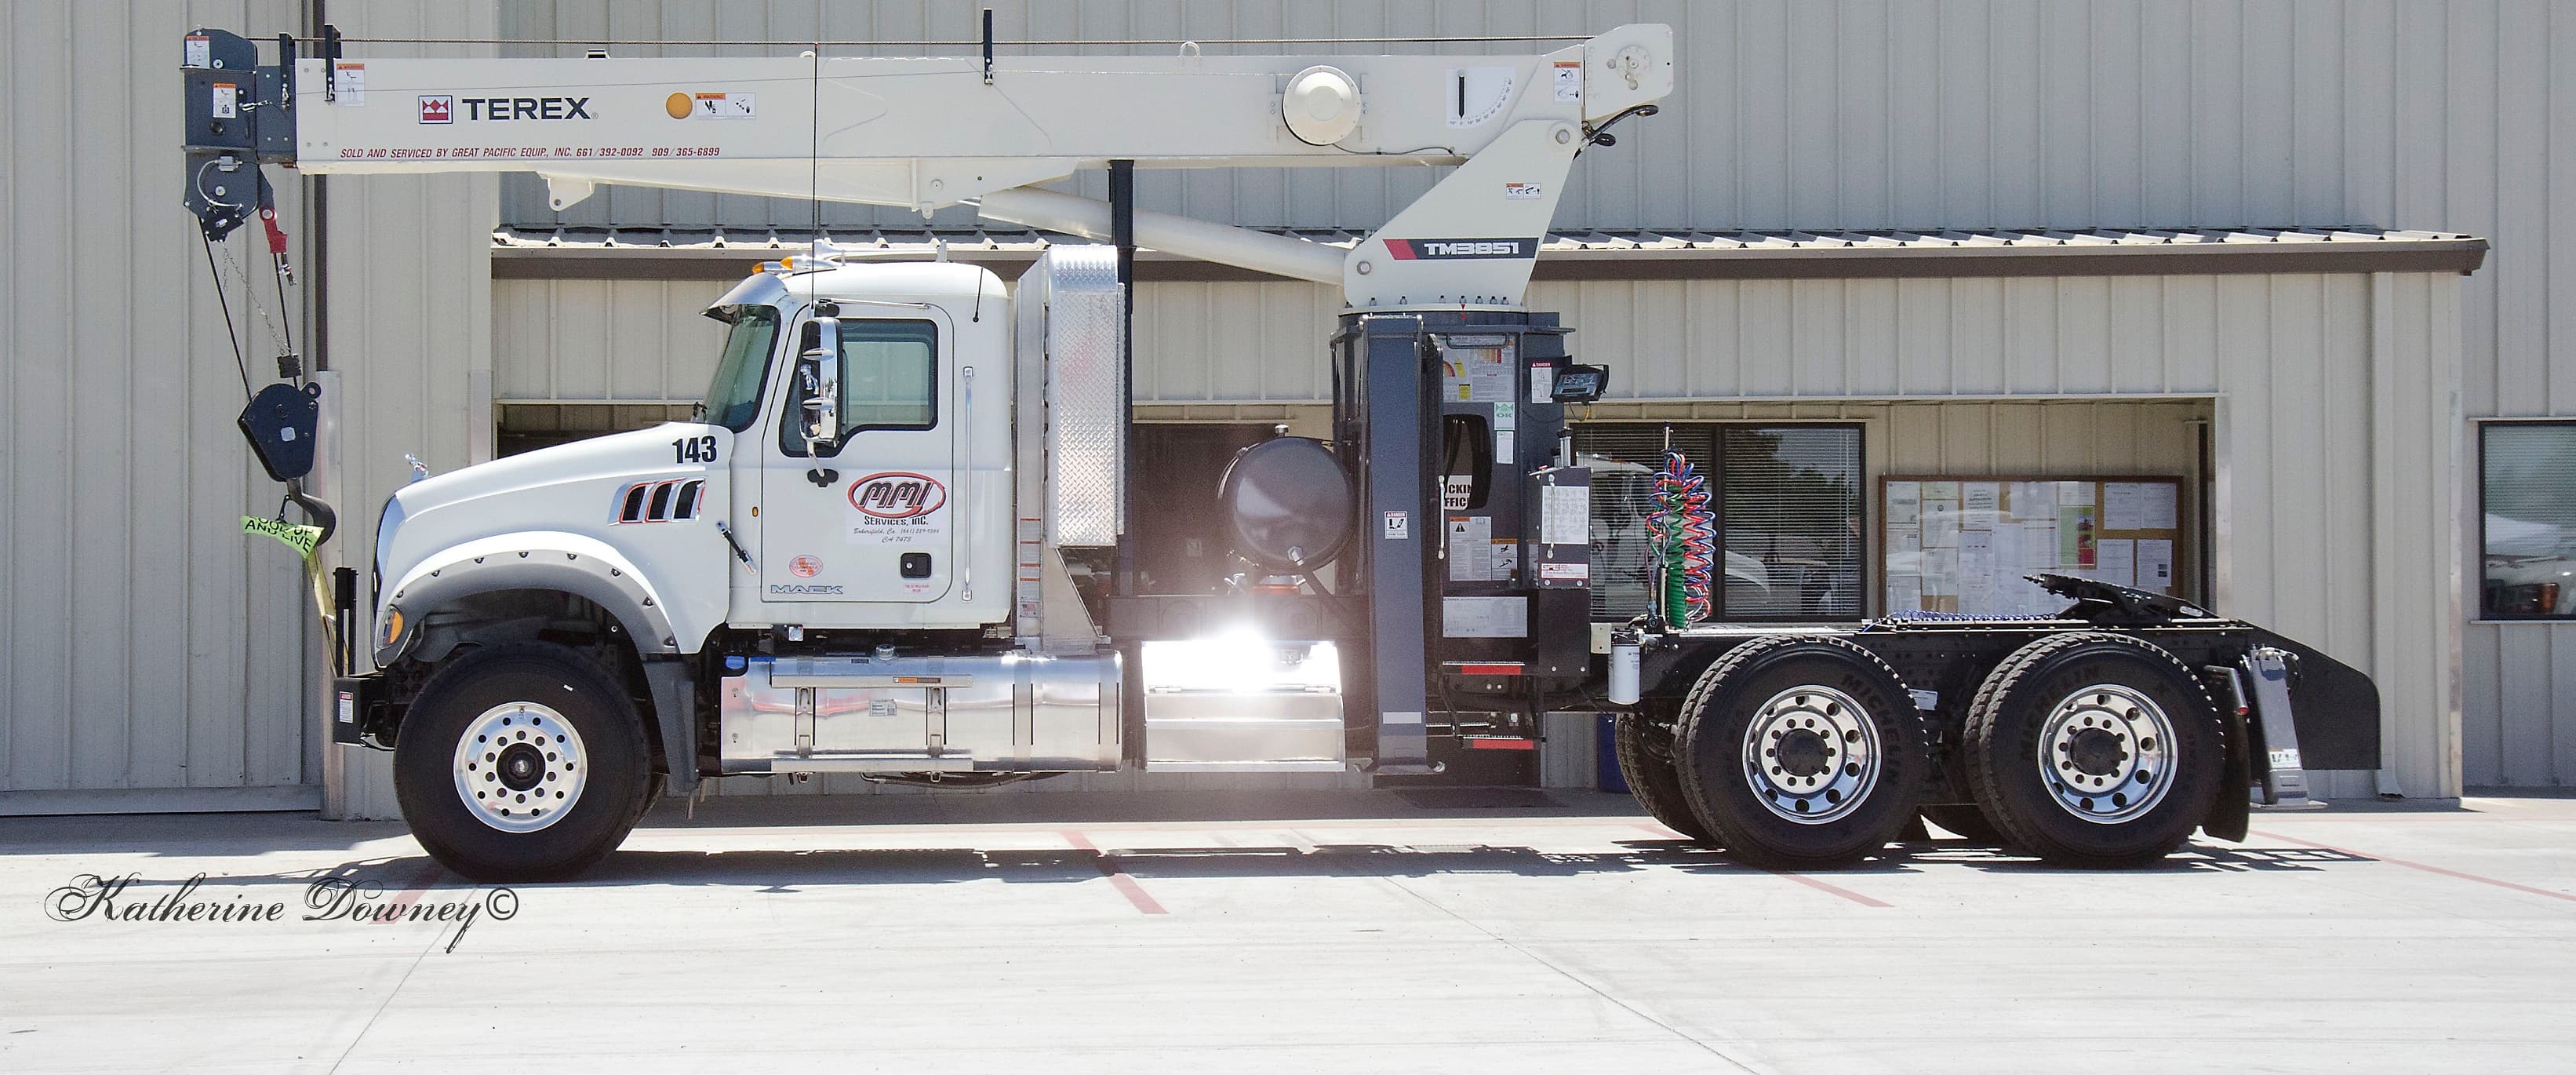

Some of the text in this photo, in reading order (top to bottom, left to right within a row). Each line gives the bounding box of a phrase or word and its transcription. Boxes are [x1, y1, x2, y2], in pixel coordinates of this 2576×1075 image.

[462, 97, 591, 120] TEREX
[340, 148, 363, 158] SOLD
[367, 148, 387, 158] AND
[391, 148, 431, 158] SERVICED
[436, 148, 449, 157] BY
[452, 148, 479, 157] GREAT
[483, 148, 516, 157] PACIFIC
[555, 148, 572, 156] INC.
[1424, 242, 1519, 255] TM3851
[672, 435, 717, 464] 143
[858, 481, 934, 509] MMI
[864, 516, 909, 527] SERVICES,
[770, 585, 843, 595] MACK
[1840, 673, 1901, 785] MICHELIN
